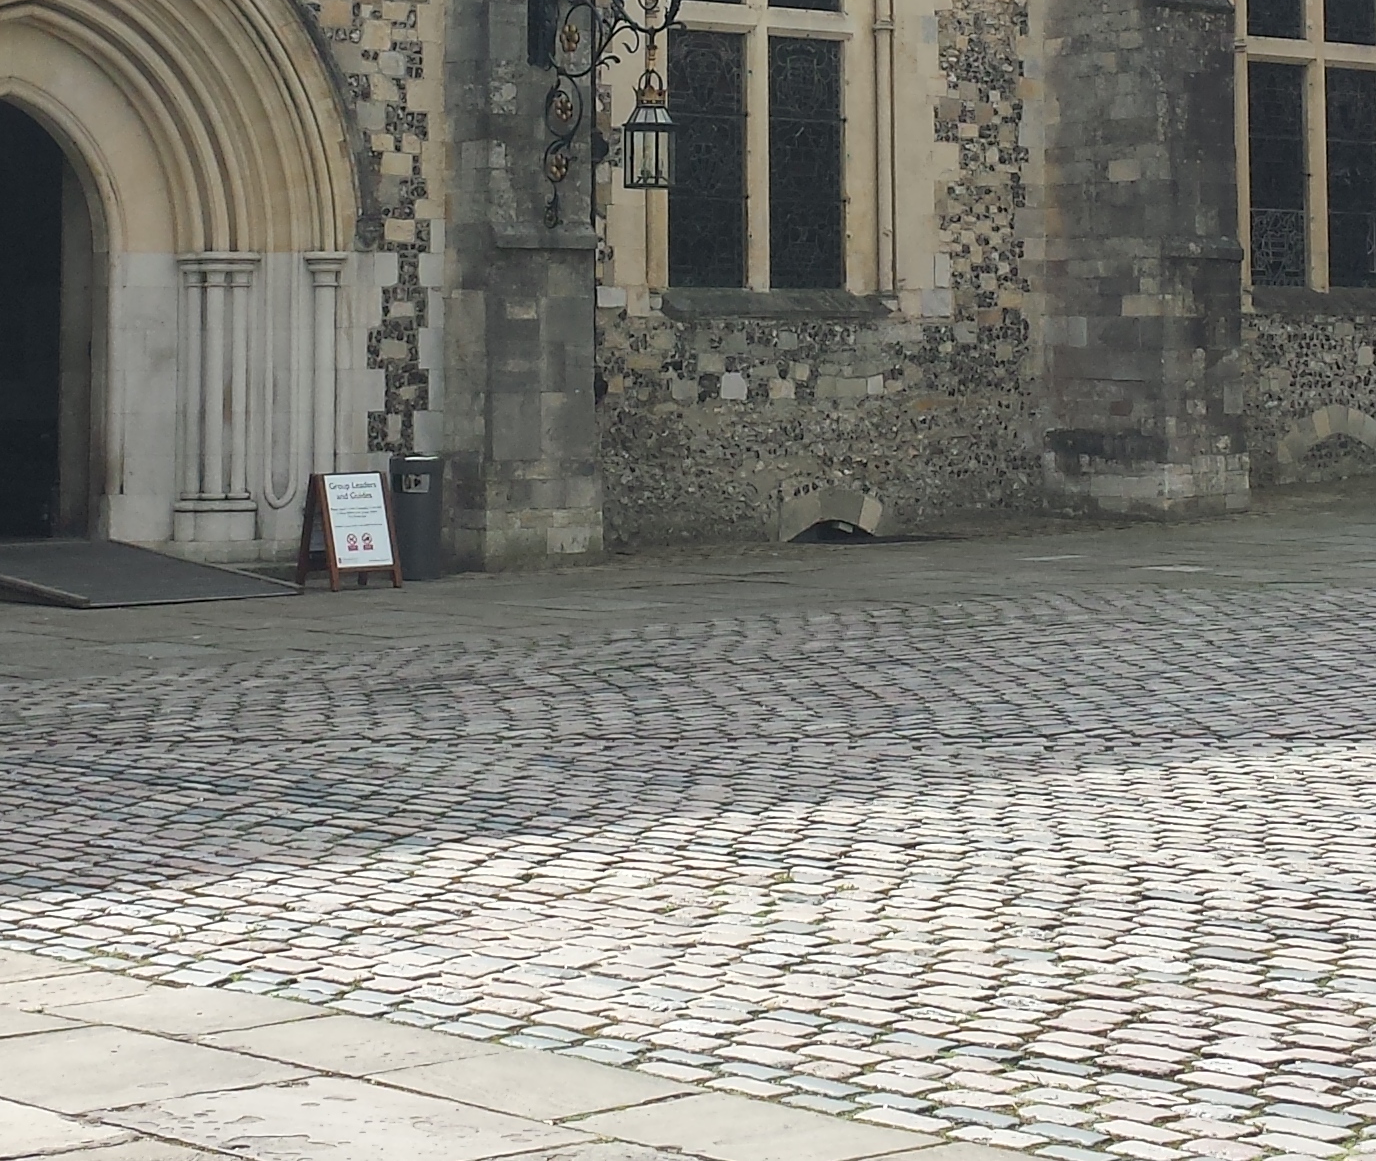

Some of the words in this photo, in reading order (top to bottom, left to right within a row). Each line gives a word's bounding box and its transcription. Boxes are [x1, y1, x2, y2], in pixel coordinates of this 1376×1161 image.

[329, 482, 350, 491] Group
[351, 481, 377, 489] Leaders
[349, 491, 373, 499] Guides
